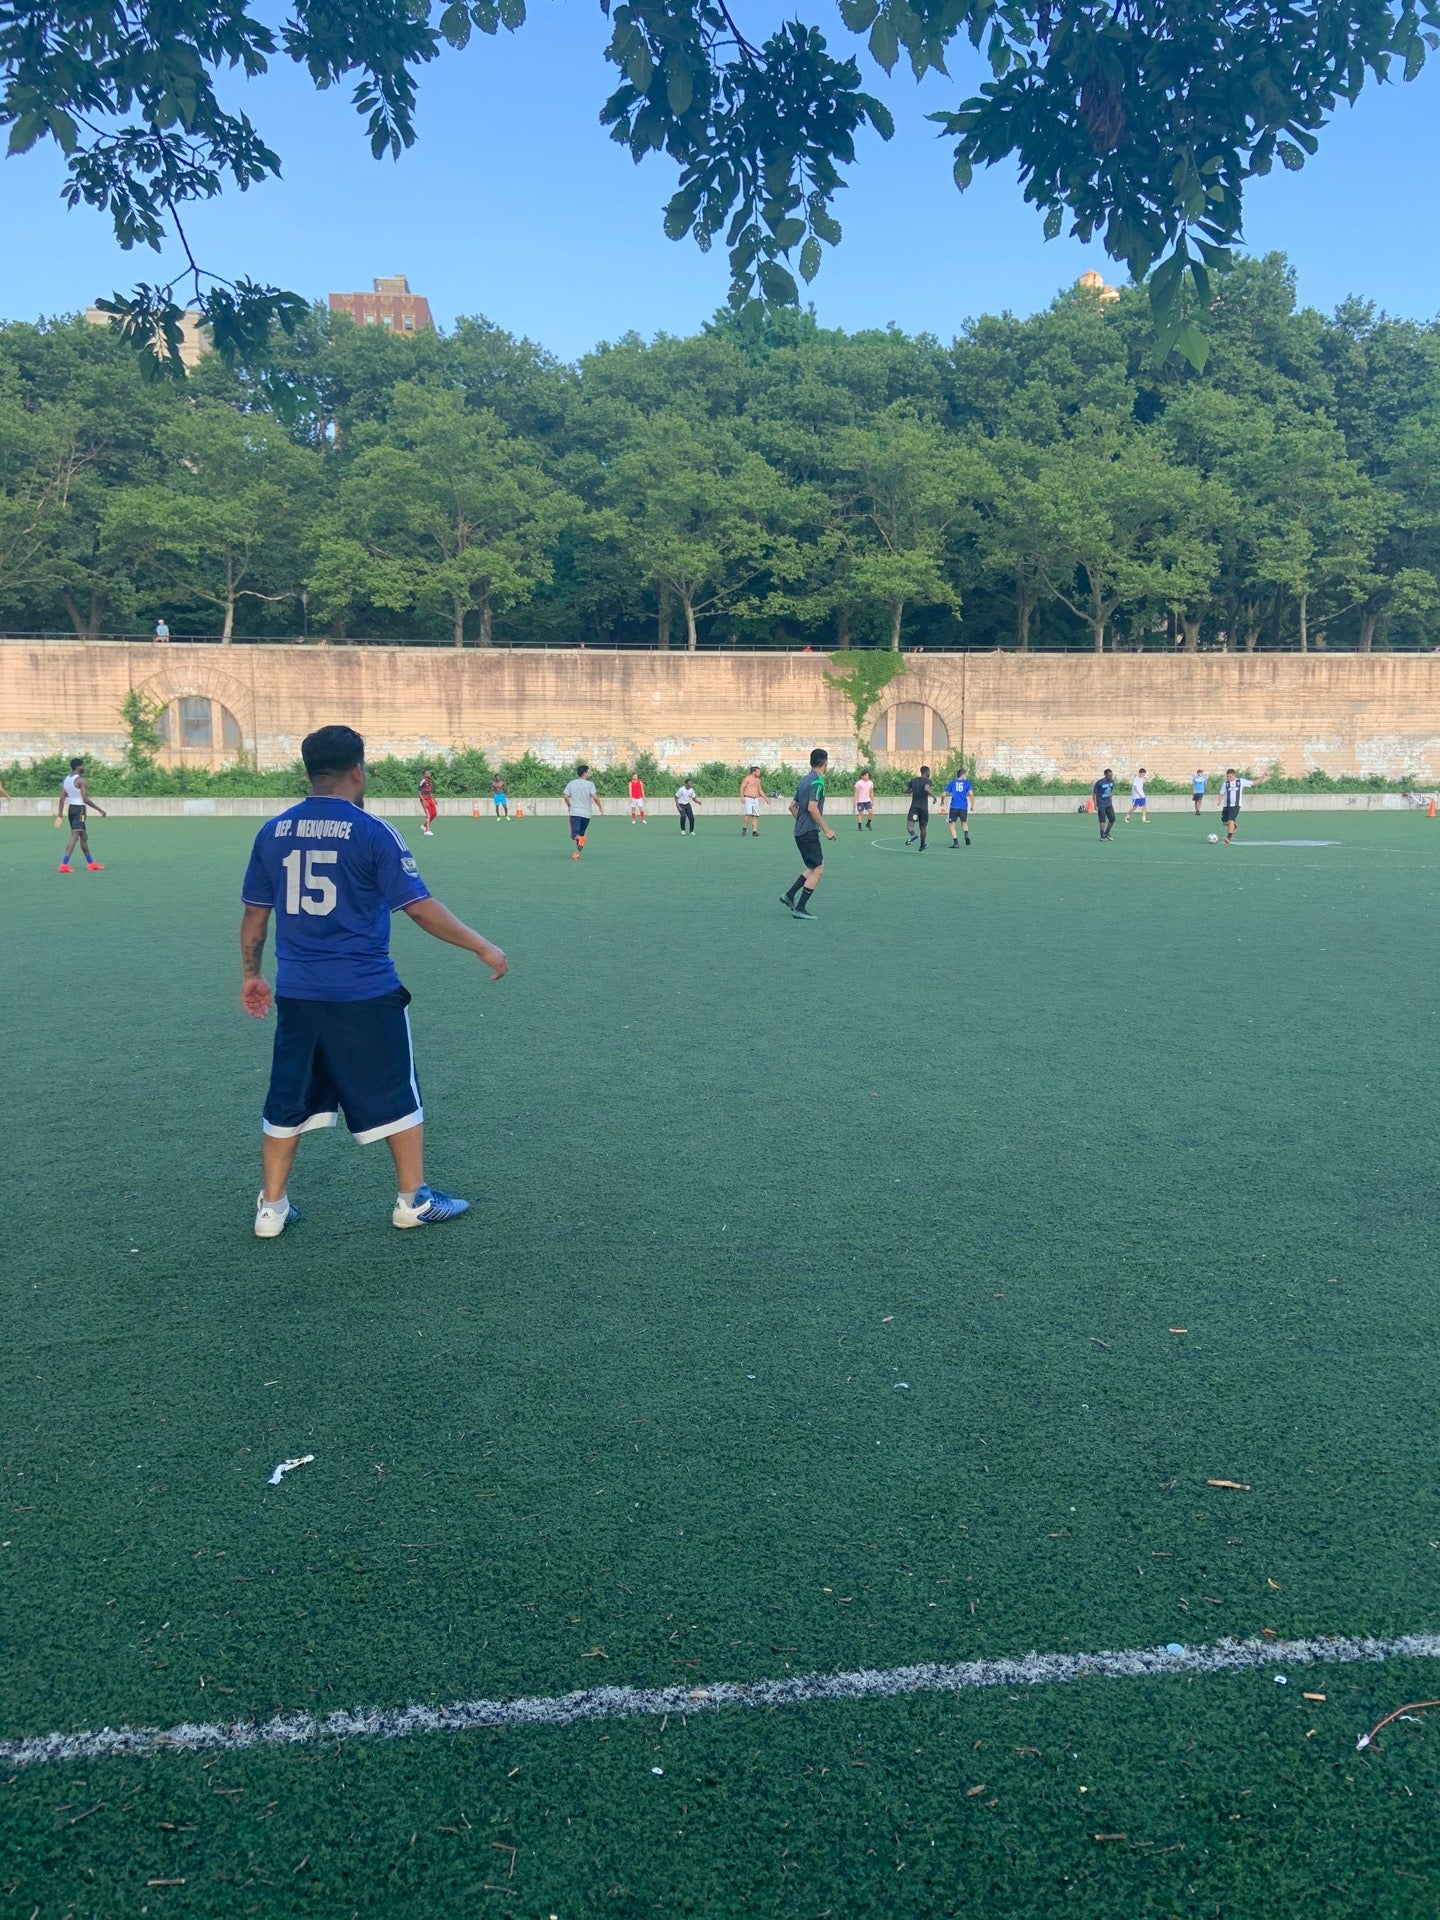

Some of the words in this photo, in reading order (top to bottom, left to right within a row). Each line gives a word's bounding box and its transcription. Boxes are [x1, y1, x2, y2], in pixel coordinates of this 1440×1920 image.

[955, 781, 964, 793] 16
[275, 819, 292, 837] DEP.
[282, 849, 338, 916] 15
